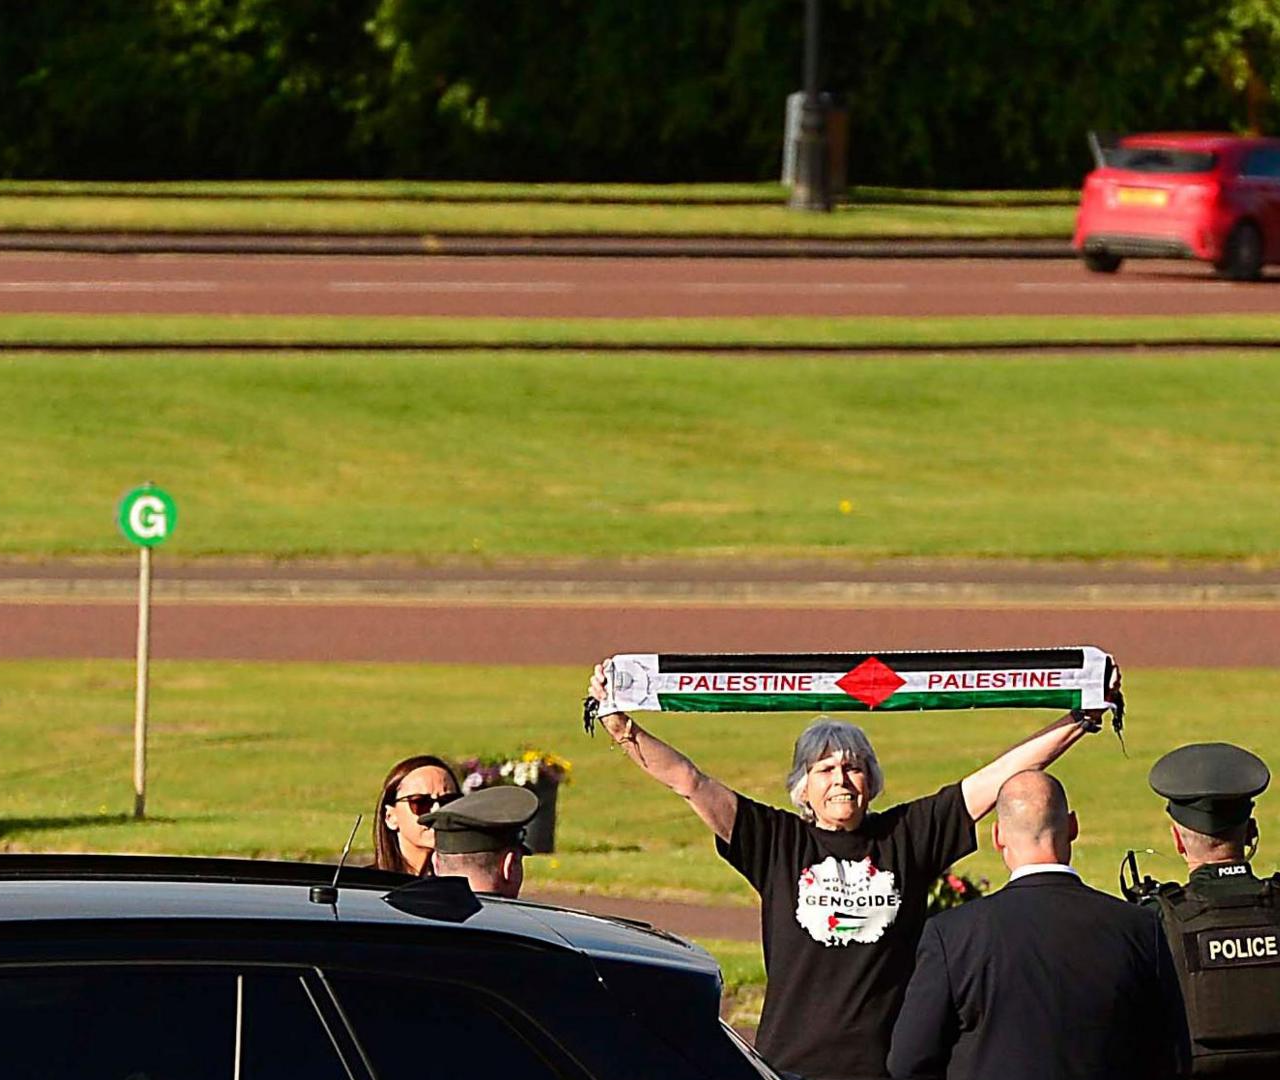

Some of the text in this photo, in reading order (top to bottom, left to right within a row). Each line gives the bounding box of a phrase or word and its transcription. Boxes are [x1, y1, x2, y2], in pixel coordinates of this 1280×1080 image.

[130, 496, 166, 538] G
[678, 671, 1062, 692] PALESTINE PALESTINE
[1218, 865, 1246, 876] POLICE
[805, 895, 896, 907] GENOCIDE
[1209, 936, 1278, 960] POLICE
